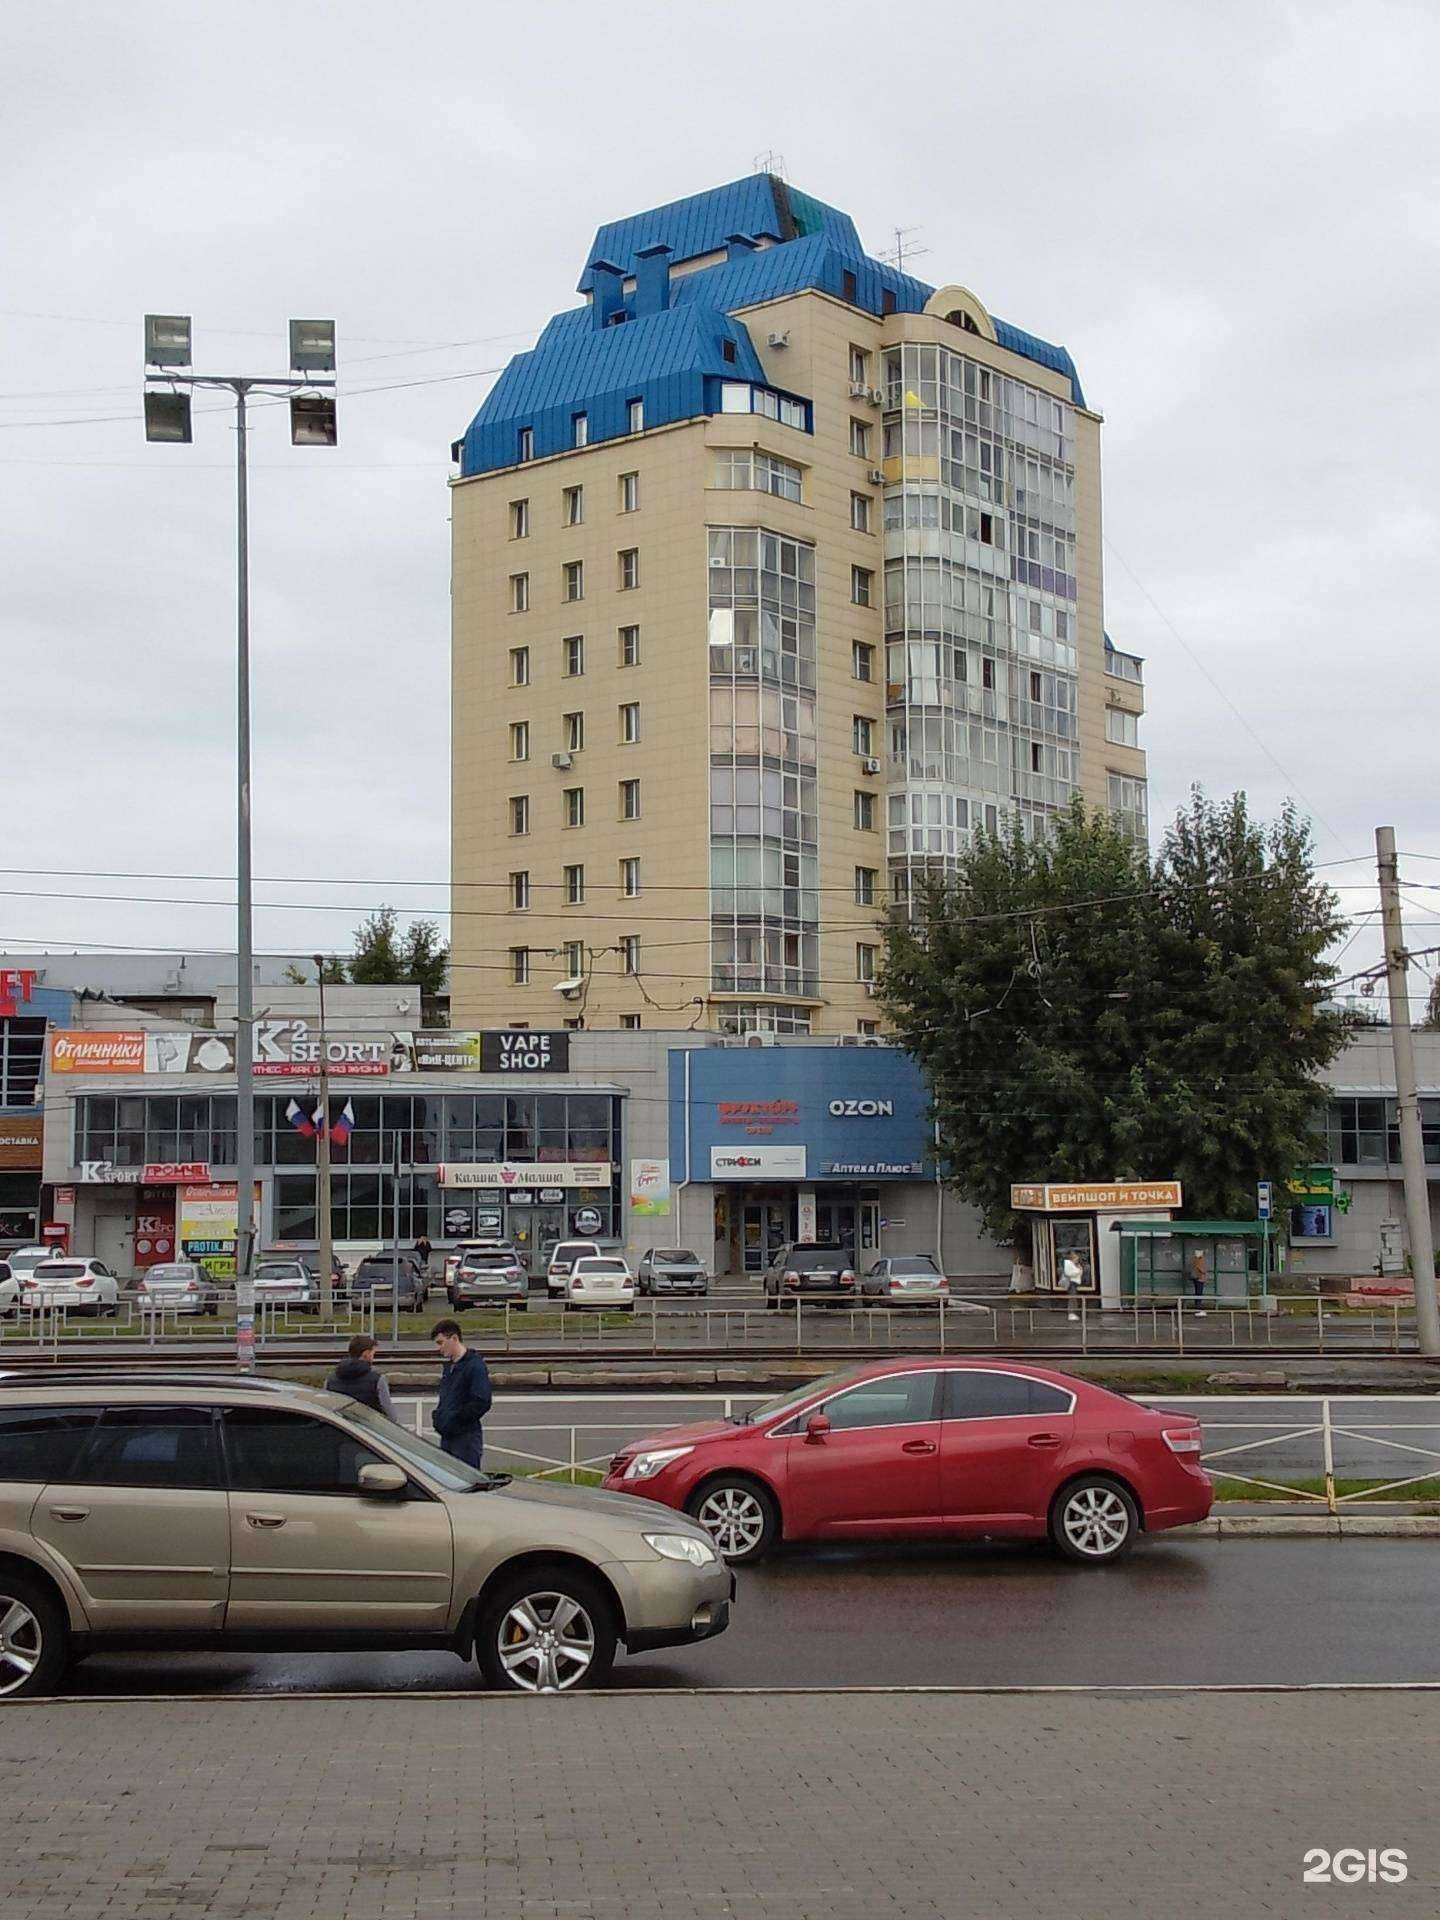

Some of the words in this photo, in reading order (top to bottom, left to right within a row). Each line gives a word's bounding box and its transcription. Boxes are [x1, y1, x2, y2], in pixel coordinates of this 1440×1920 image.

[500, 1036, 550, 1050] VAPE
[500, 1053, 550, 1068] SHOP
[313, 1065, 346, 1074] ОРАЗ
[829, 1099, 894, 1117] OZON
[1131, 1190, 1173, 1200] ТОЧКА
